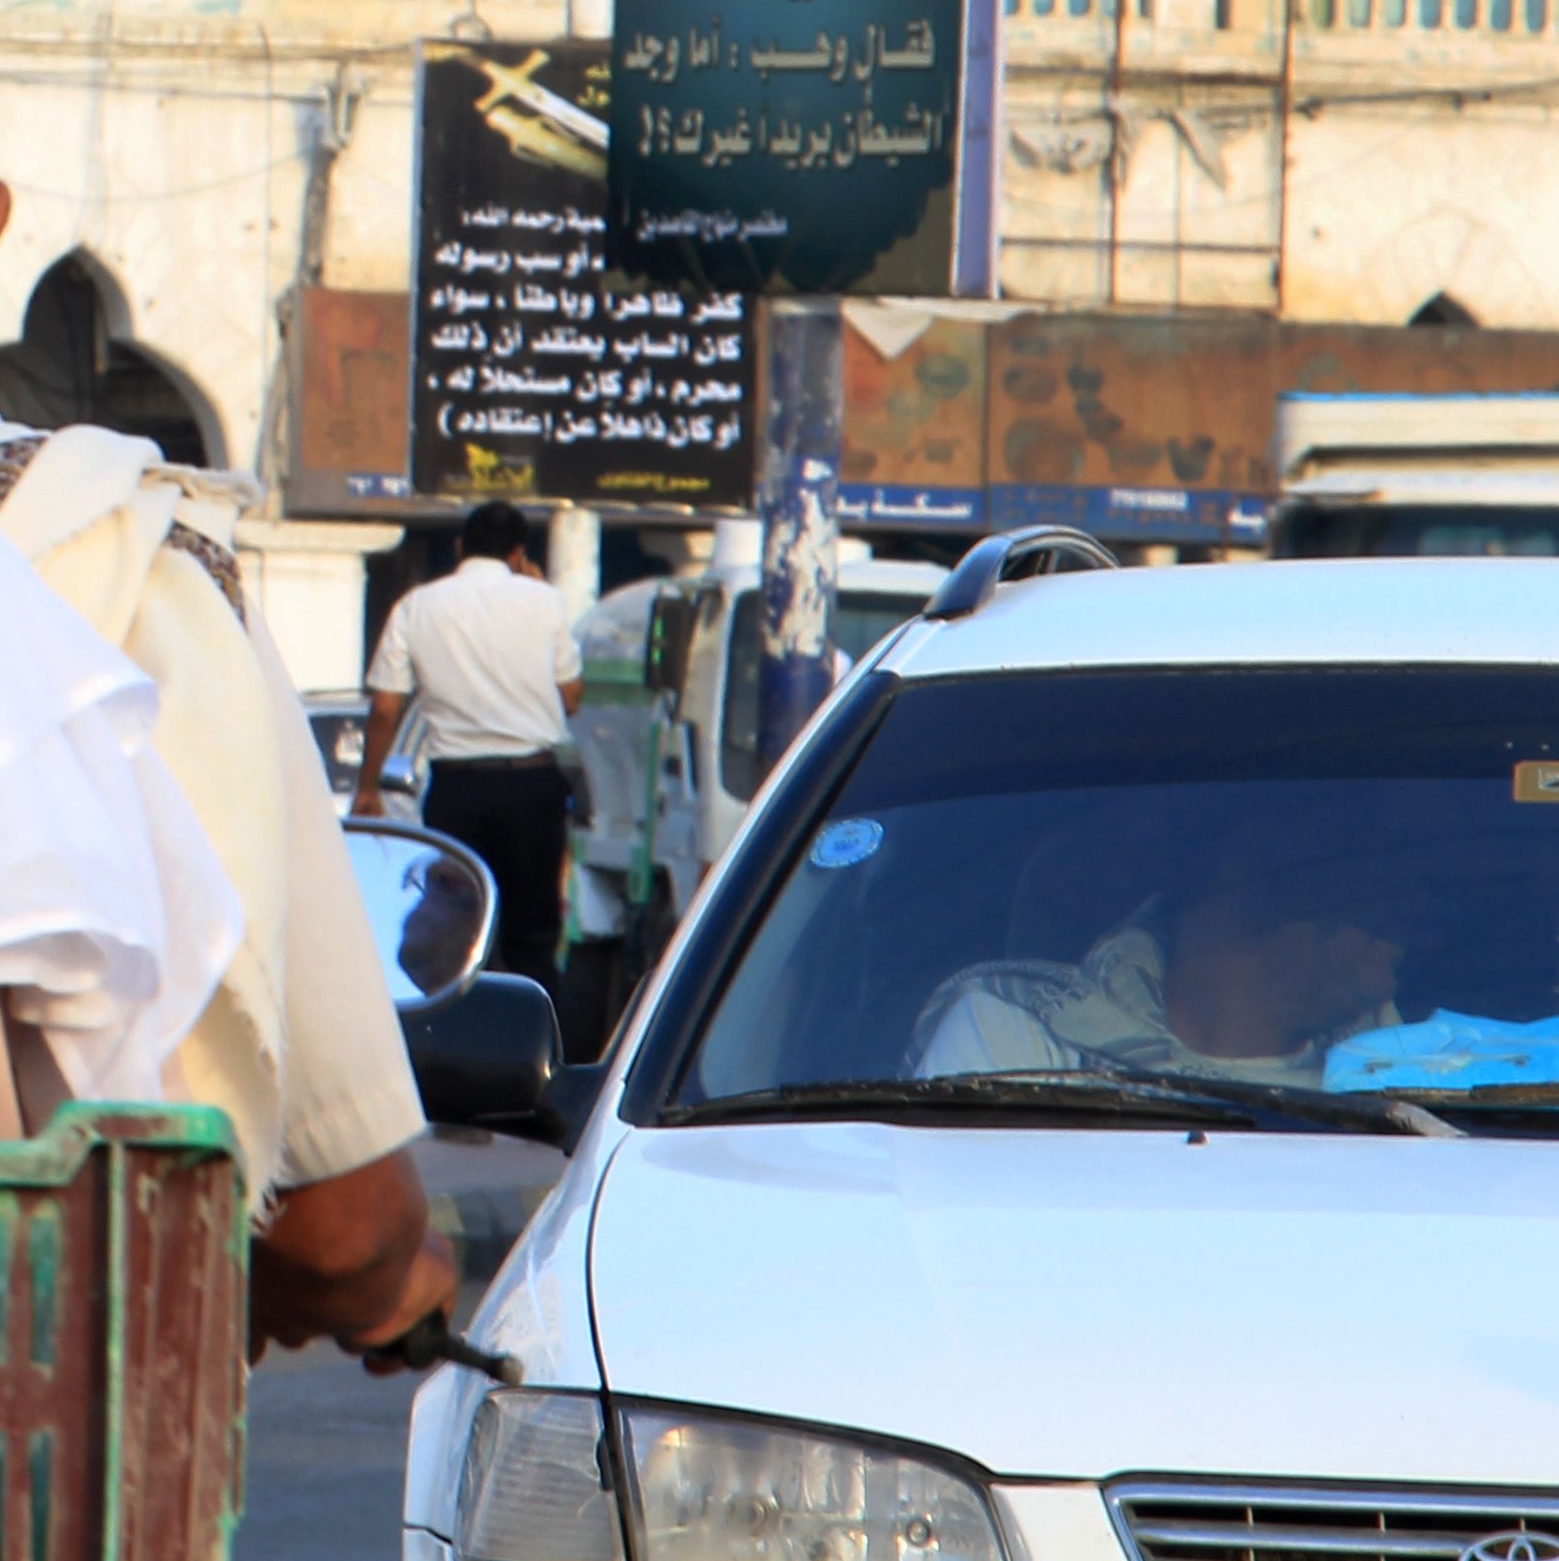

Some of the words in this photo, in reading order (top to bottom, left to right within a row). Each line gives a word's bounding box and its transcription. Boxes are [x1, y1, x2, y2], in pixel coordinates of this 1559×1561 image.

[625, 30, 680, 83] وجد
[749, 32, 849, 83] وهب
[854, 18, 935, 81] فقال
[512, 209, 566, 233] رحمه
[435, 240, 512, 275] رسوله
[515, 252, 563, 275] سب
[430, 283, 490, 315] سواء
[690, 291, 742, 326] كفر
[432, 320, 488, 352] ذلك
[531, 325, 606, 363] يعتقد
[614, 331, 690, 364] الساب
[694, 333, 741, 366] كان
[446, 365, 477, 390] له
[575, 370, 623, 403] كان
[671, 379, 743, 408] محرم
[554, 410, 598, 445] عن
[665, 414, 714, 450] كان
